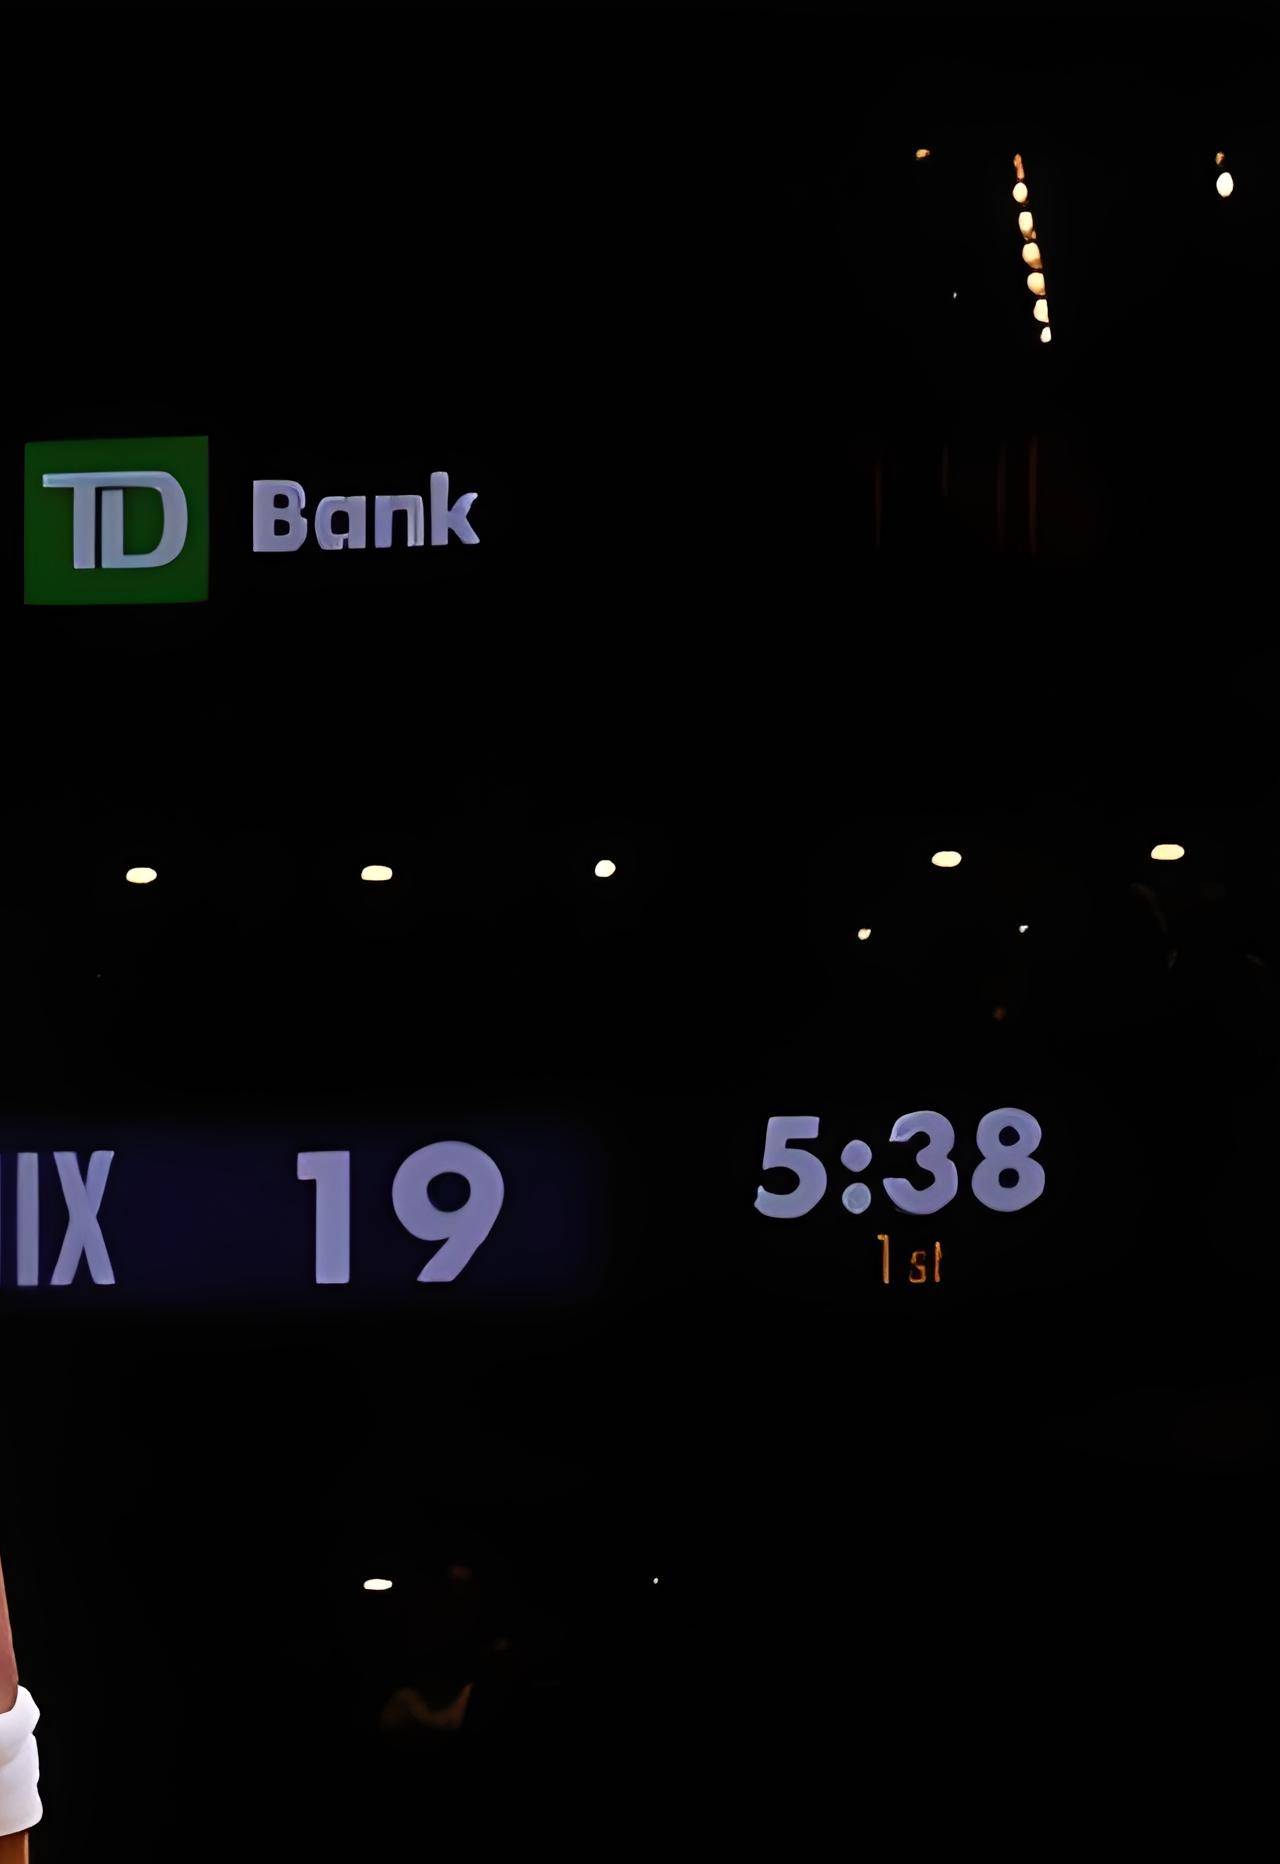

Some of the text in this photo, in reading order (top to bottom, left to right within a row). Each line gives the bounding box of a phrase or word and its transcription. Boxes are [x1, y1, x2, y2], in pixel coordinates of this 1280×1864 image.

[42, 470, 481, 570] TD Bank
[296, 1139, 506, 1285] 19
[753, 1106, 1046, 1219] 5:38
[875, 1231, 944, 1286] 1st
